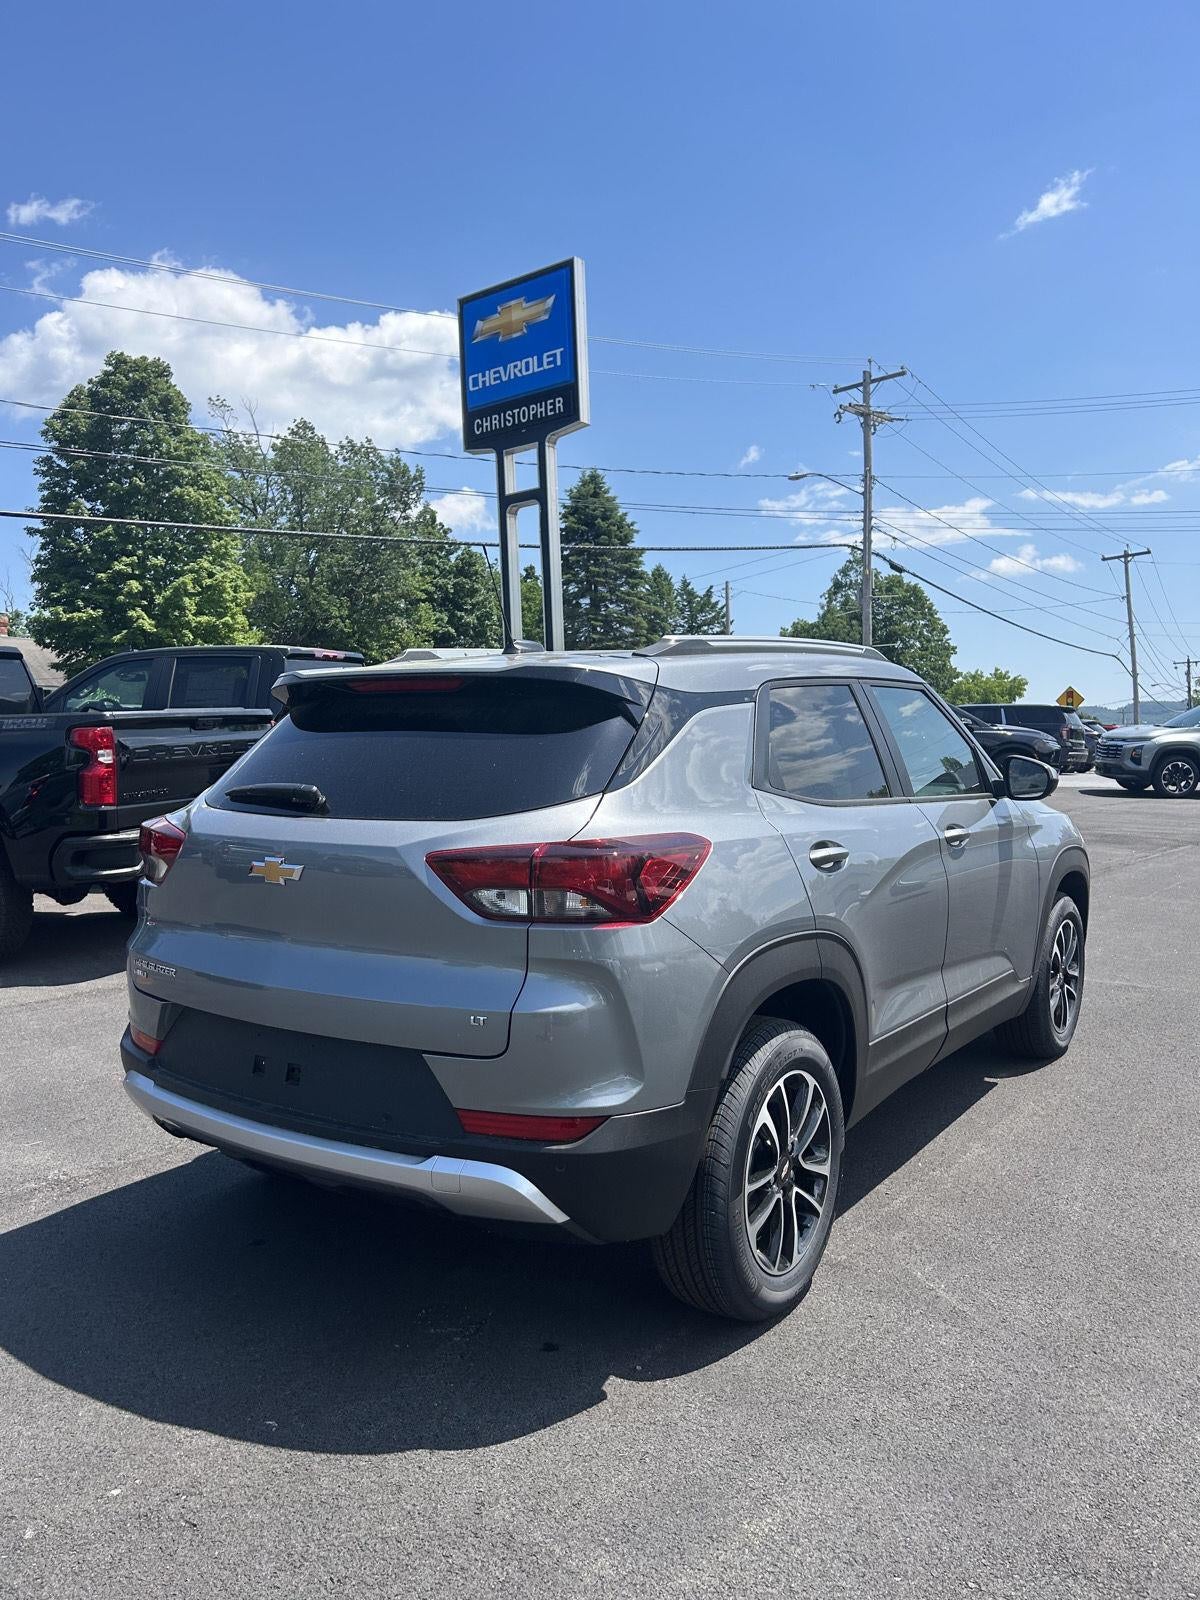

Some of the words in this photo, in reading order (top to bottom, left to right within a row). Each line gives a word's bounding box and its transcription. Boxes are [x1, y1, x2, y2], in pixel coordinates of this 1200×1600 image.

[468, 347, 564, 392] CHEVROLET
[474, 397, 564, 435] CHRISTOPHER
[470, 1015, 488, 1026] LT
